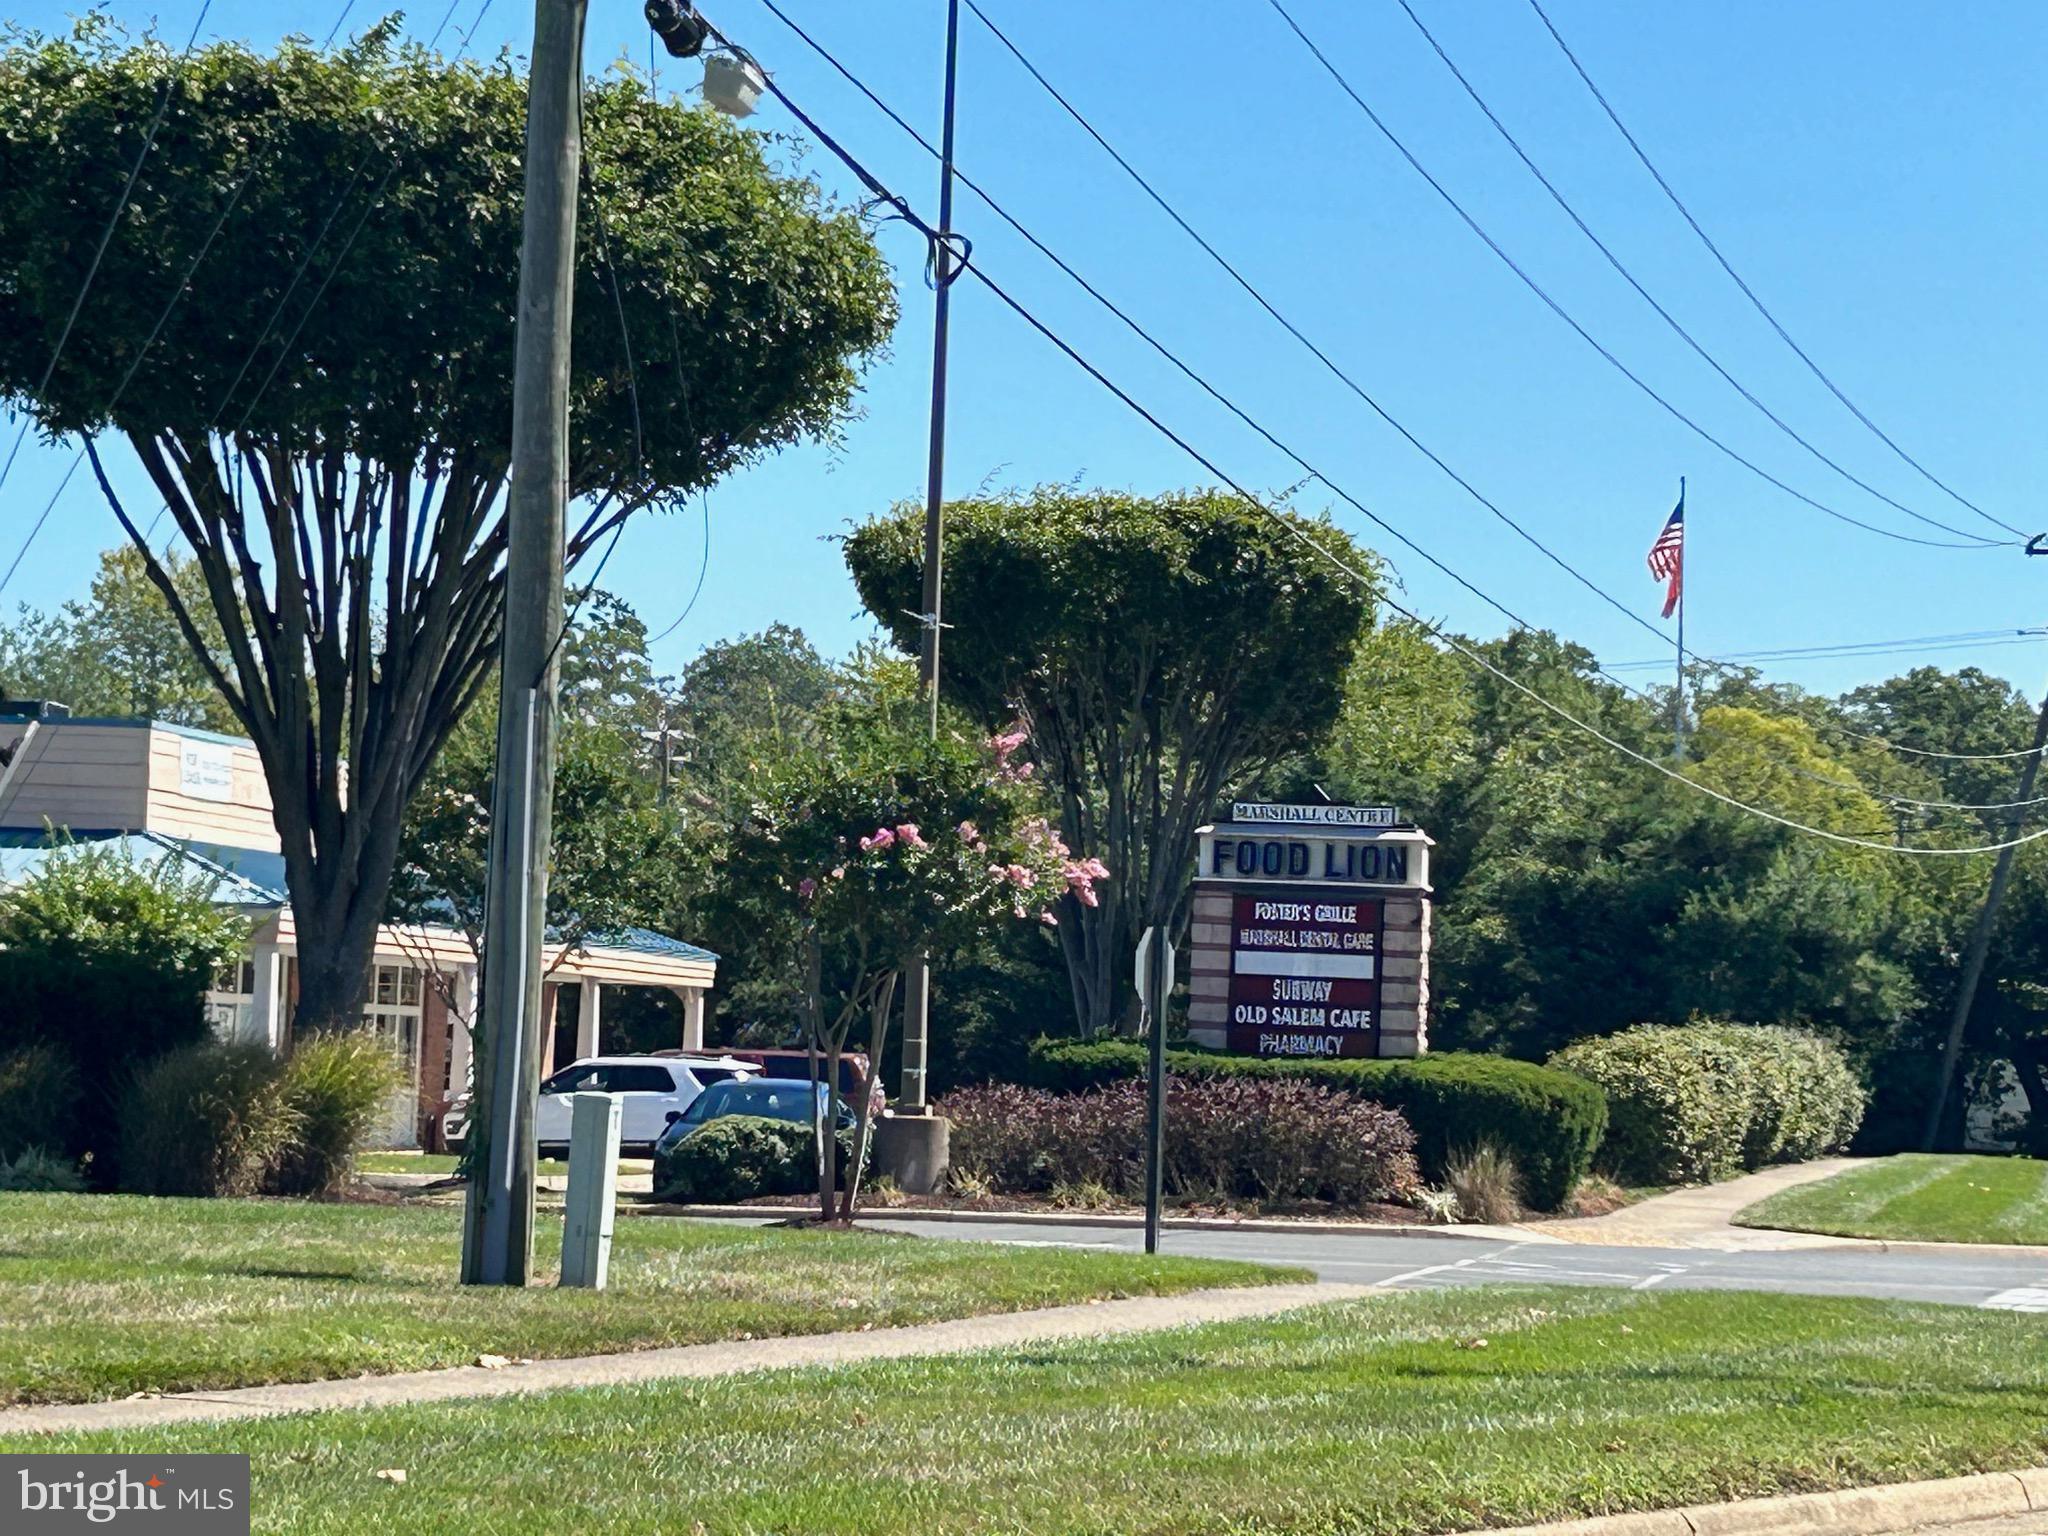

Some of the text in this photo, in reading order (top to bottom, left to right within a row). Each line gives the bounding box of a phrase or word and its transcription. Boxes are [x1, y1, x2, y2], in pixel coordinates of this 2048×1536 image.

[1235, 803, 1320, 821] MARSHALL
[1213, 840, 1408, 880] FOOD LION
[1272, 978, 1333, 1002] SUBWAY
[1235, 1004, 1372, 1029] OLD SALEM CAFE
[1259, 1033, 1344, 1055] PHARMACY
